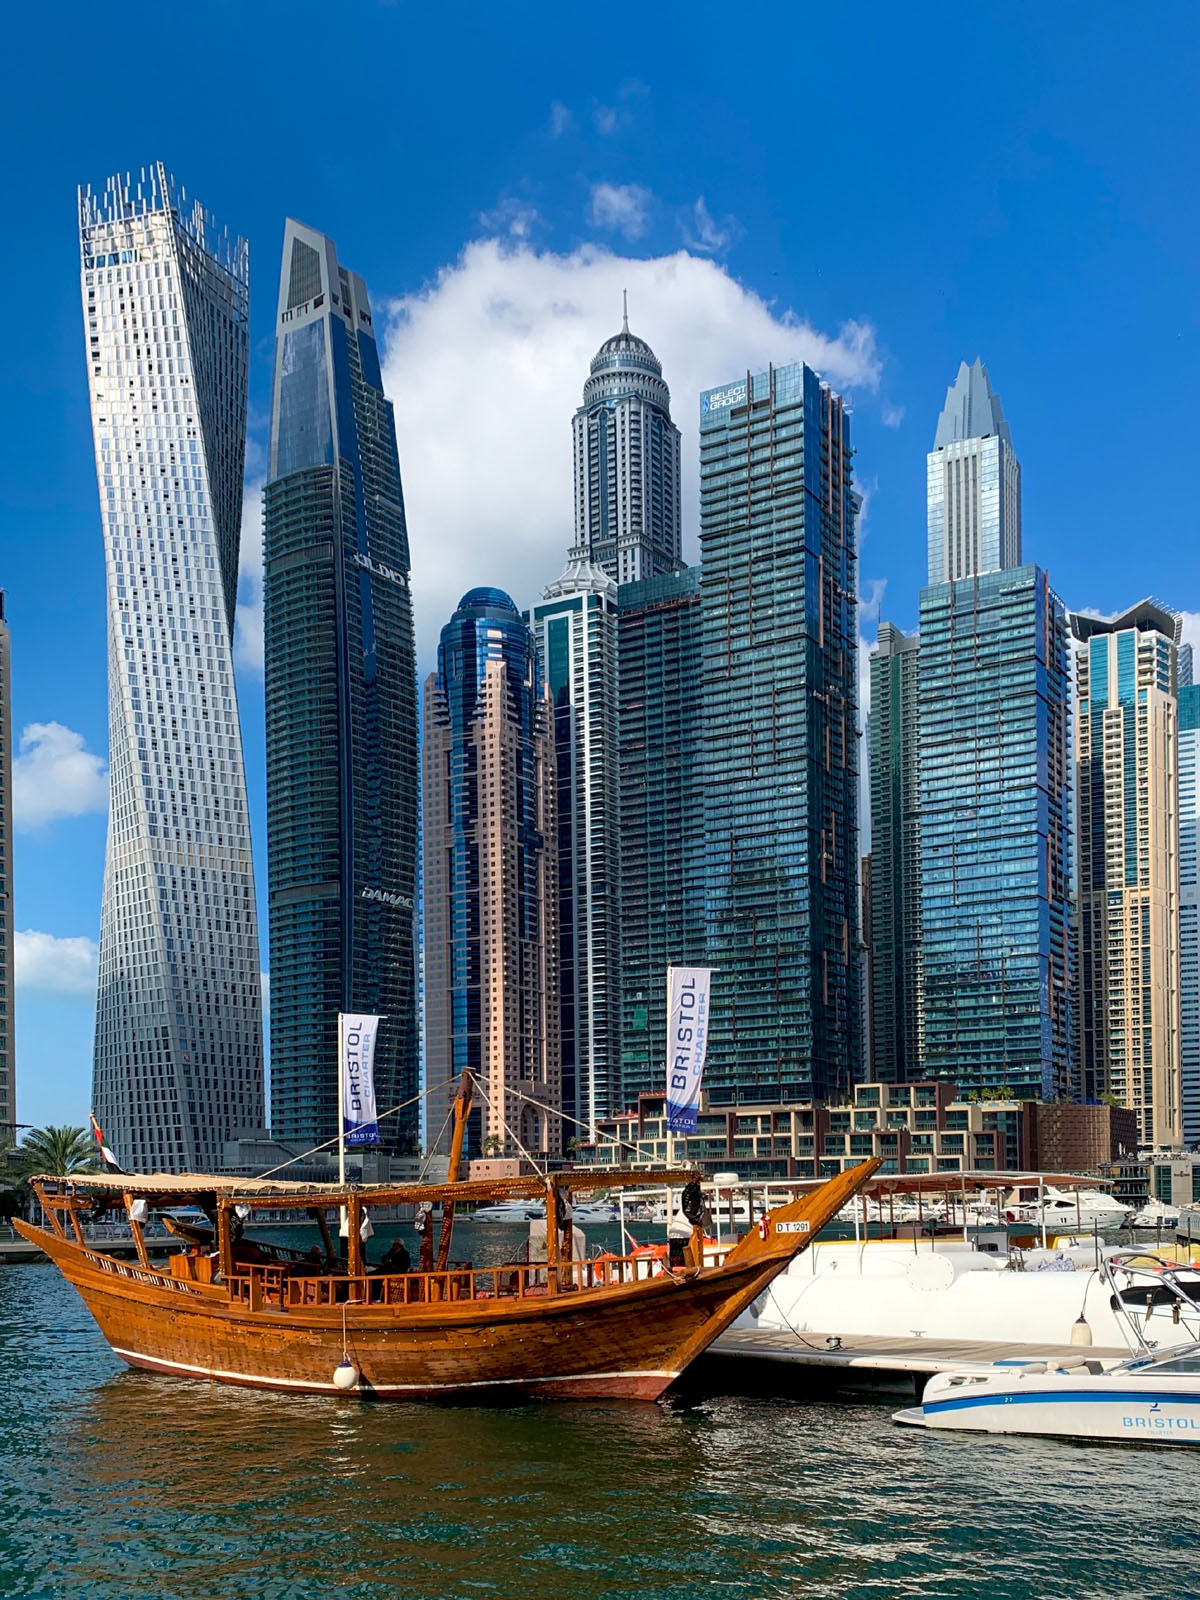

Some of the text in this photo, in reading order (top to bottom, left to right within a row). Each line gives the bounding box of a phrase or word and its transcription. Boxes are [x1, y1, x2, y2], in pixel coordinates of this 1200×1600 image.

[710, 385, 746, 402] SELECT
[710, 394, 746, 410] GROUP
[361, 887, 414, 908] DAMAC
[671, 977, 696, 1090] BRISTOL
[692, 992, 706, 1076] CHARTER
[347, 1022, 363, 1111] BRISTOL
[362, 1033, 371, 1098] CHARTER
[793, 1223, 808, 1231] 1291
[1122, 1416, 1200, 1430] BRISTOL
